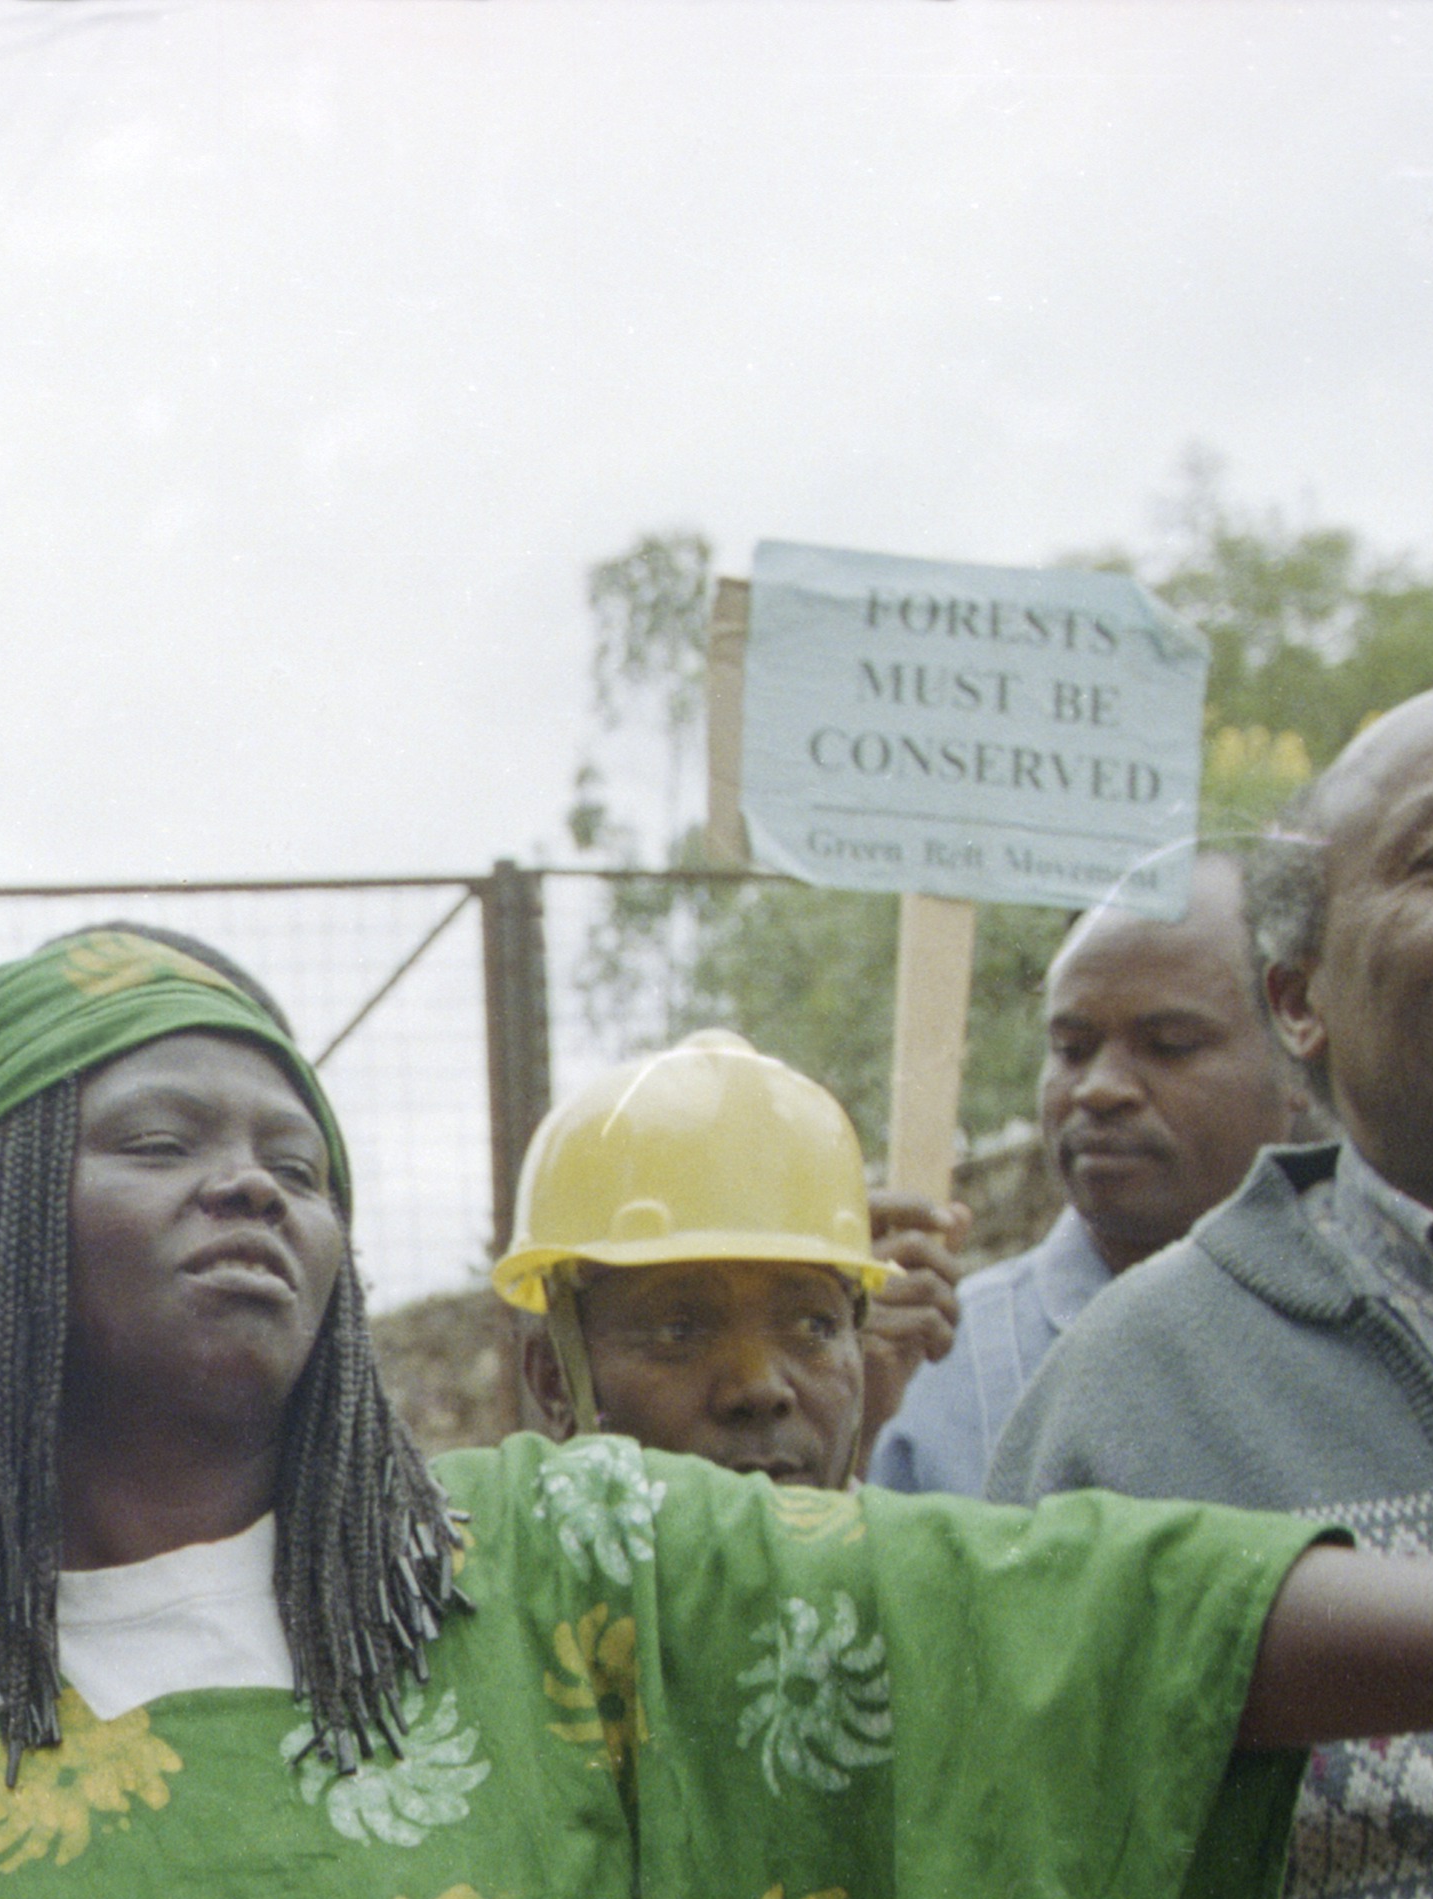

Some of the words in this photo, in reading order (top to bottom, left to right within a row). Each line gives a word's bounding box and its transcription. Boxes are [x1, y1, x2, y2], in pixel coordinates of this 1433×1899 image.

[864, 589, 1119, 653] FORESTS
[858, 659, 1024, 716] MUST
[1052, 677, 1125, 727] BE
[807, 728, 1164, 806] CONSERVED
[806, 827, 902, 864] Green
[1006, 845, 1159, 892] Movement
